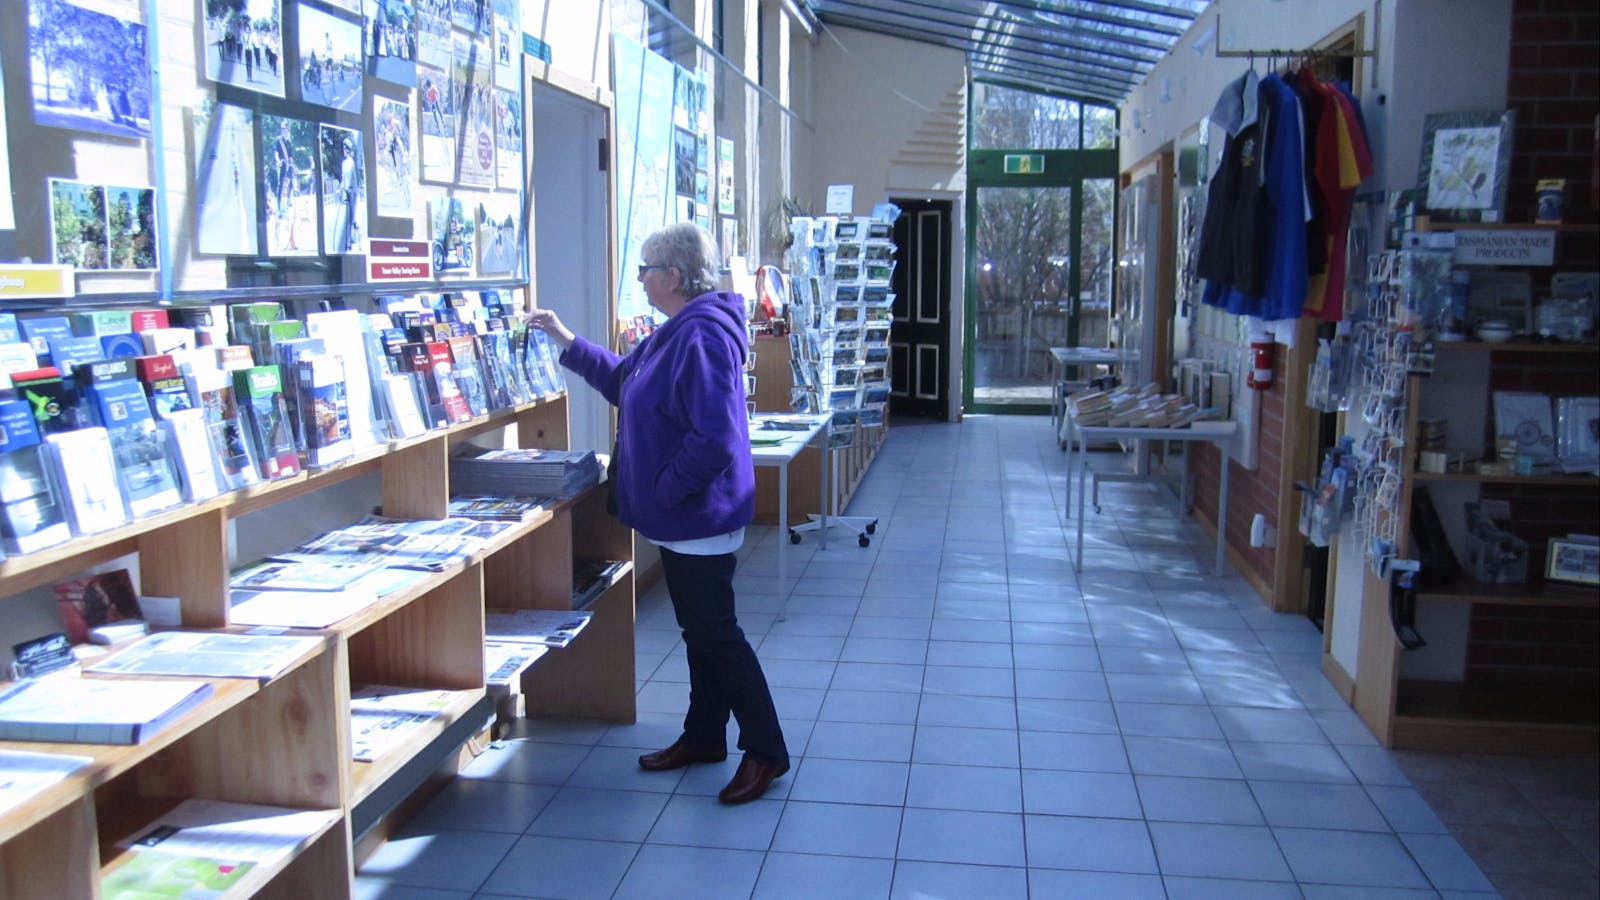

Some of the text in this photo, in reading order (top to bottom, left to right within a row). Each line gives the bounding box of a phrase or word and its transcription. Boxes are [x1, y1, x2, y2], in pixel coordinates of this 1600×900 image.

[1457, 236, 1552, 248] TASMANIAN MADE
[1474, 247, 1531, 258] PRODUCTS
